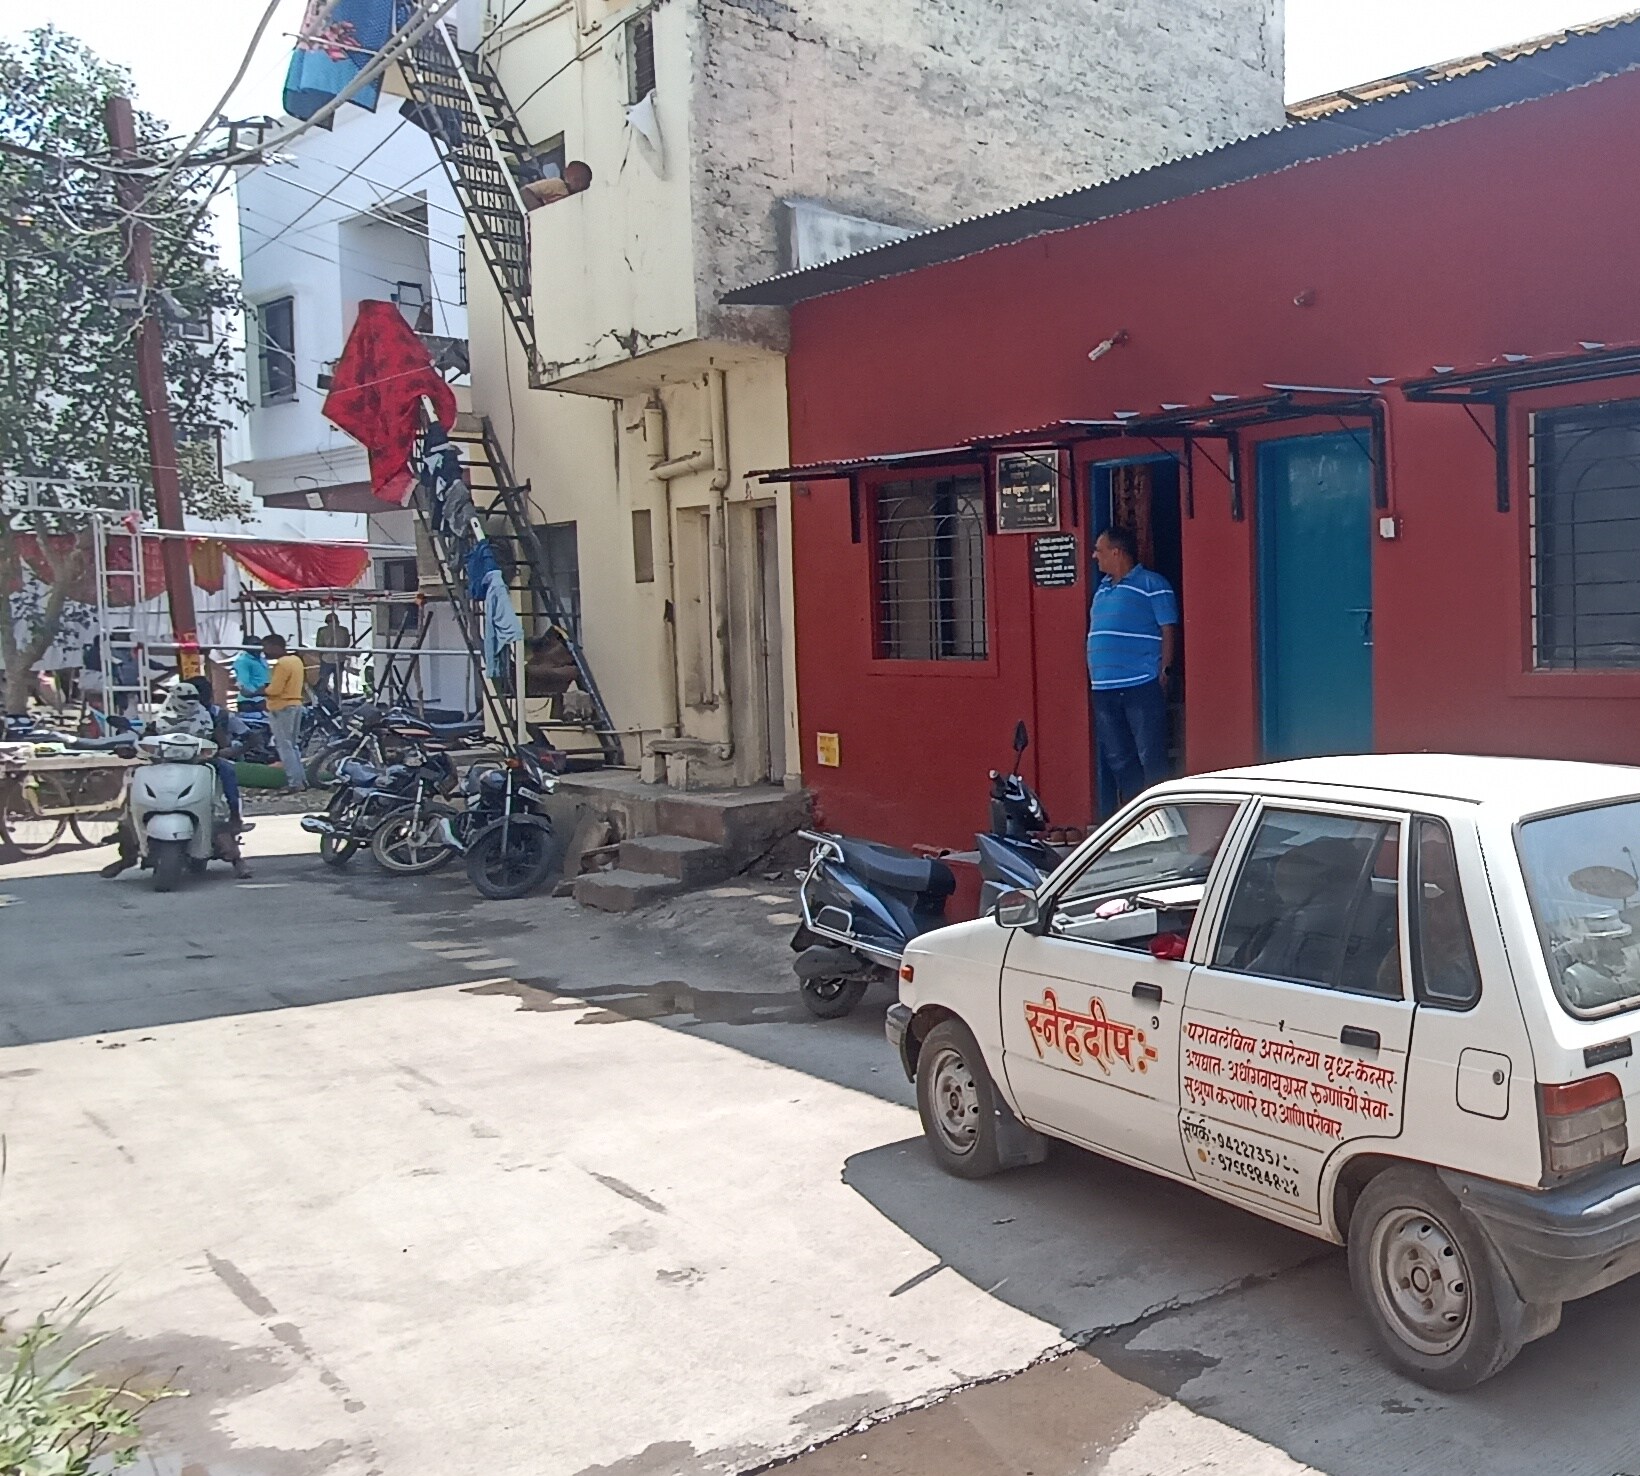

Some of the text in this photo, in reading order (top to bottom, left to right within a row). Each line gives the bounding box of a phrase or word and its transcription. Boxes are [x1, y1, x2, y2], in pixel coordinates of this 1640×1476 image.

[1259, 1039, 1320, 1070] असलेल्या
[1216, 1086, 1258, 1118] करणारे
[1260, 1098, 1279, 1123] घर
[1279, 1103, 1306, 1131] आणि
